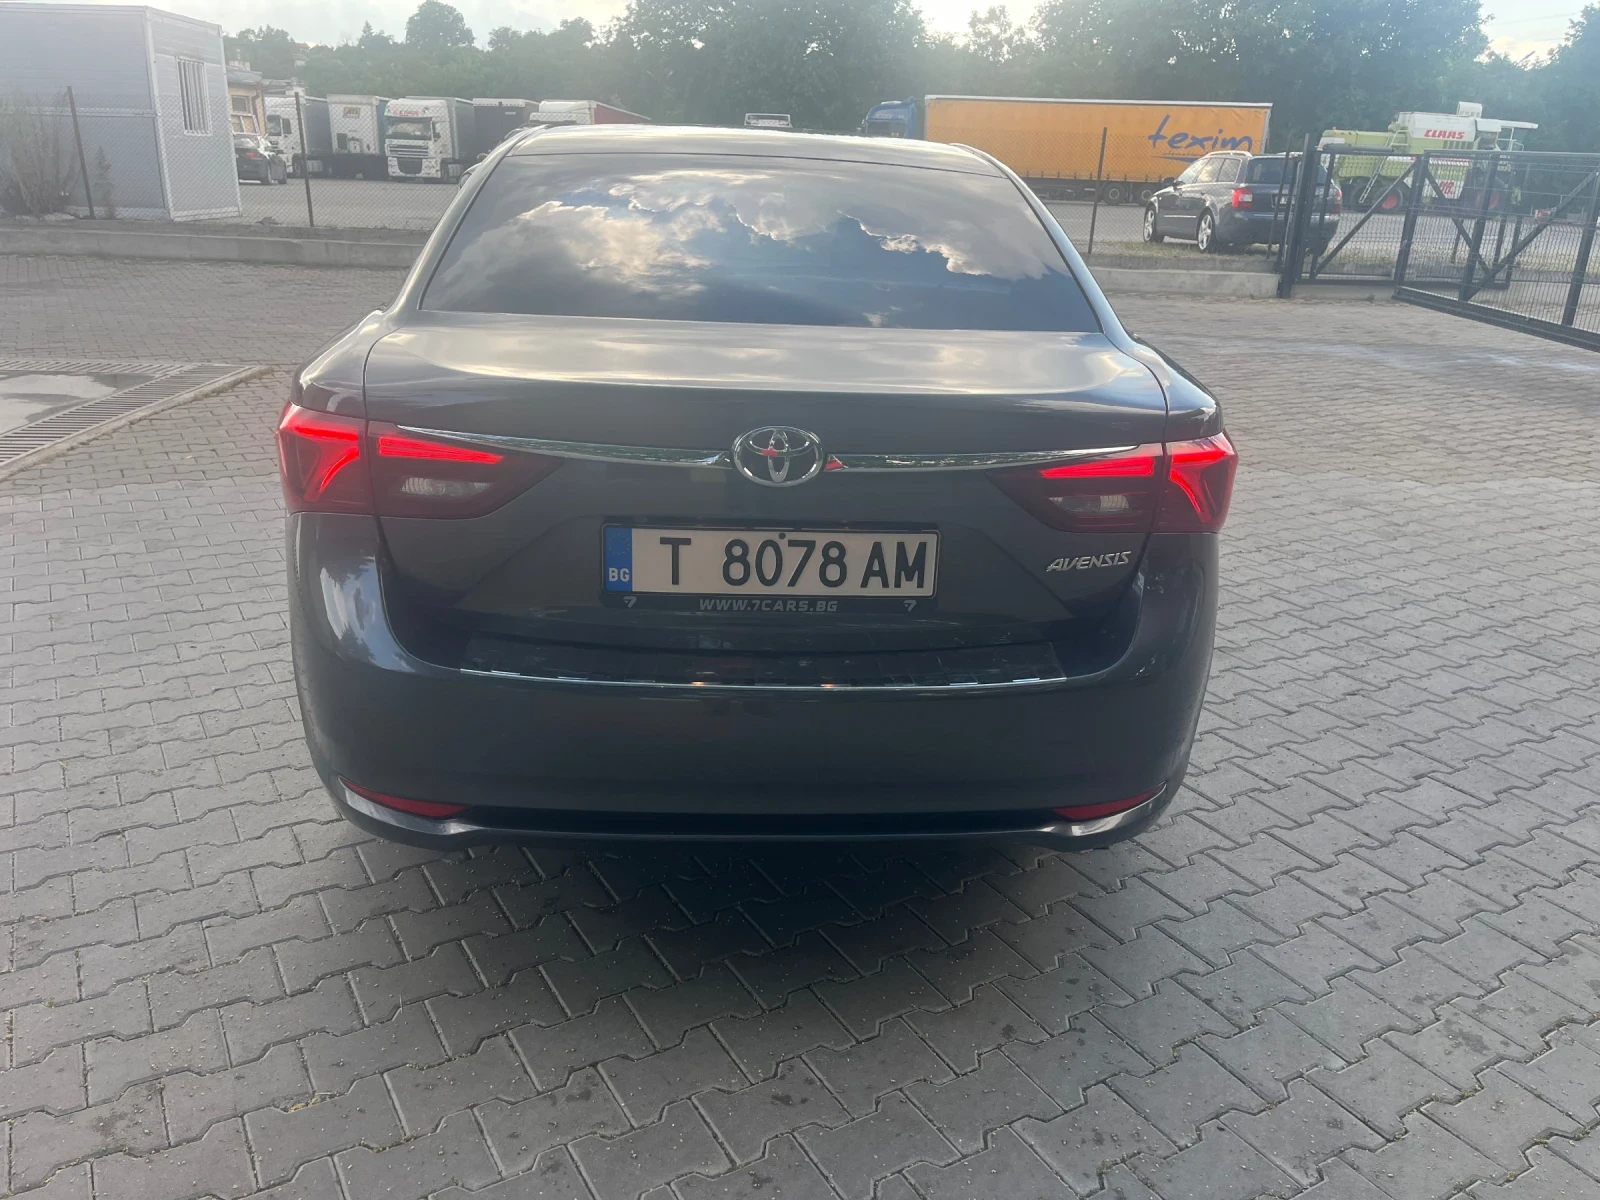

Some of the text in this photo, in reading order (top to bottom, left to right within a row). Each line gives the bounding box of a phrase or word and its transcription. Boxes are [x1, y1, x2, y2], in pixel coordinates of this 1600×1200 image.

[1147, 114, 1253, 152] texim
[1424, 129, 1465, 140] CLAAS
[660, 537, 928, 589] T 8078 AM
[1046, 550, 1132, 571] AVENSIS
[608, 567, 630, 582] BG
[699, 599, 838, 612] WWW.7CARS.BG
